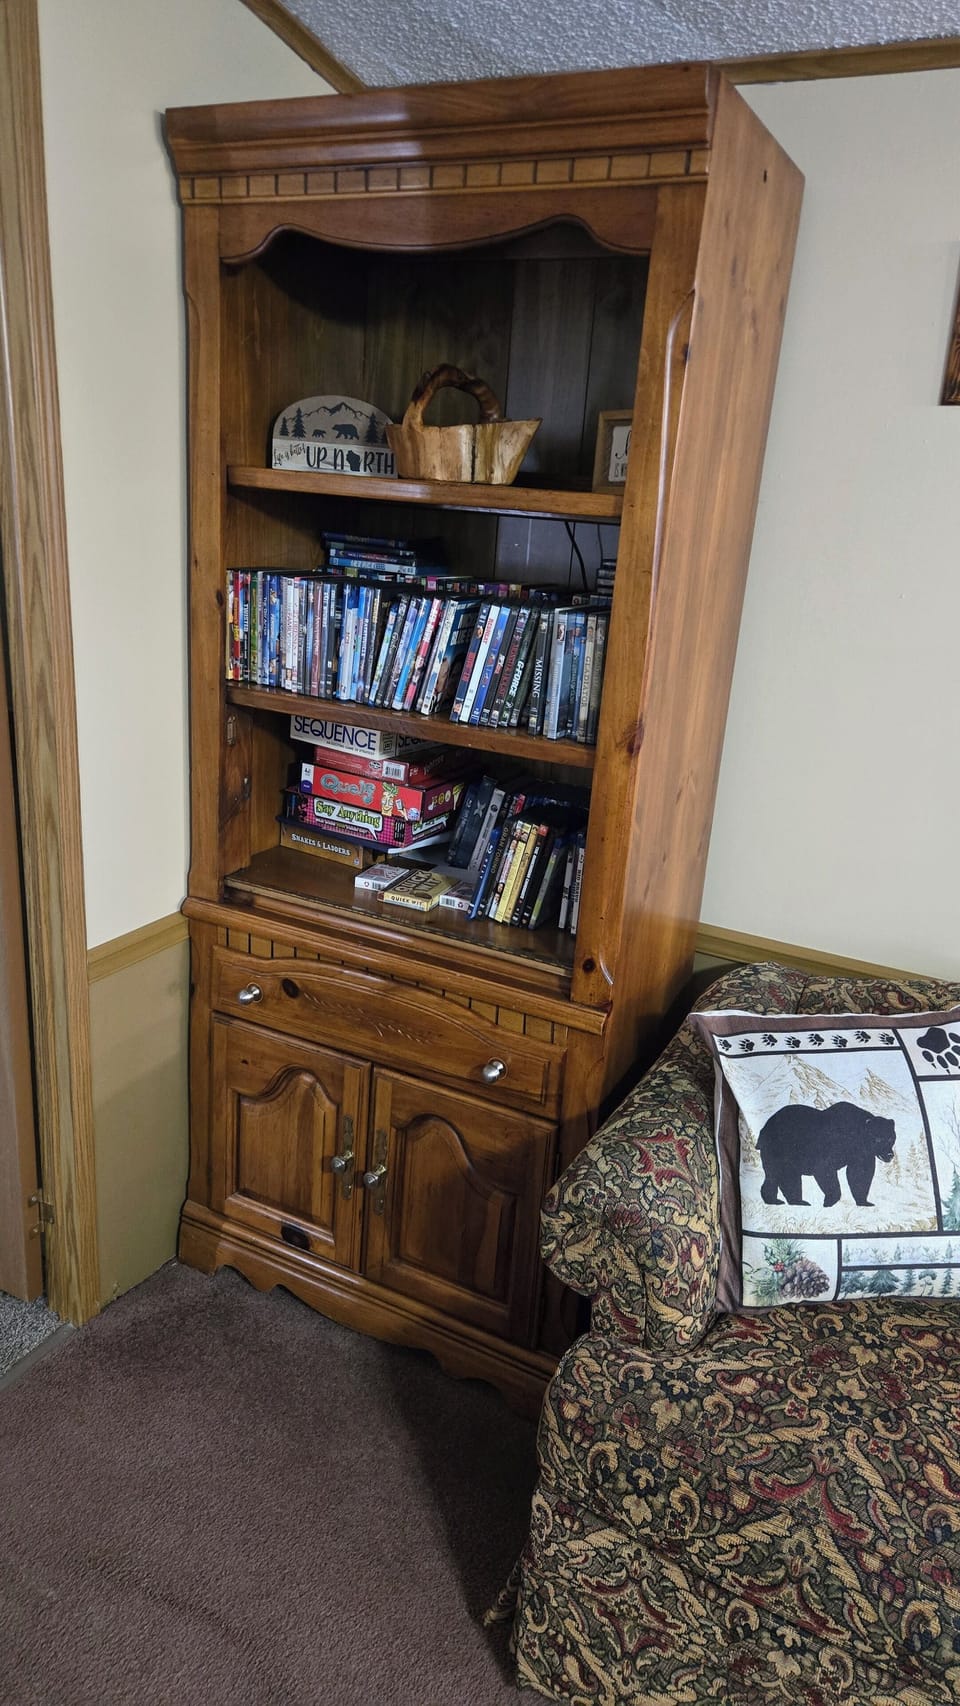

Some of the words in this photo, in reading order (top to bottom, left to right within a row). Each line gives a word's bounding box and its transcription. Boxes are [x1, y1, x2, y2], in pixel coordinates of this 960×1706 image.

[306, 446, 328, 469] UP
[508, 659, 524, 697] G-FORCE
[531, 658, 543, 698] MISSING
[581, 655, 591, 708] GLADIATOR
[294, 716, 377, 750] SEQUENCE
[315, 801, 334, 816] Say
[337, 806, 380, 829] Anything
[291, 833, 316, 846] SNAKES
[323, 842, 351, 856] LADDERS
[498, 826, 508, 846] GRAN
[489, 847, 502, 874] TORINO
[394, 870, 432, 892] QUICK
